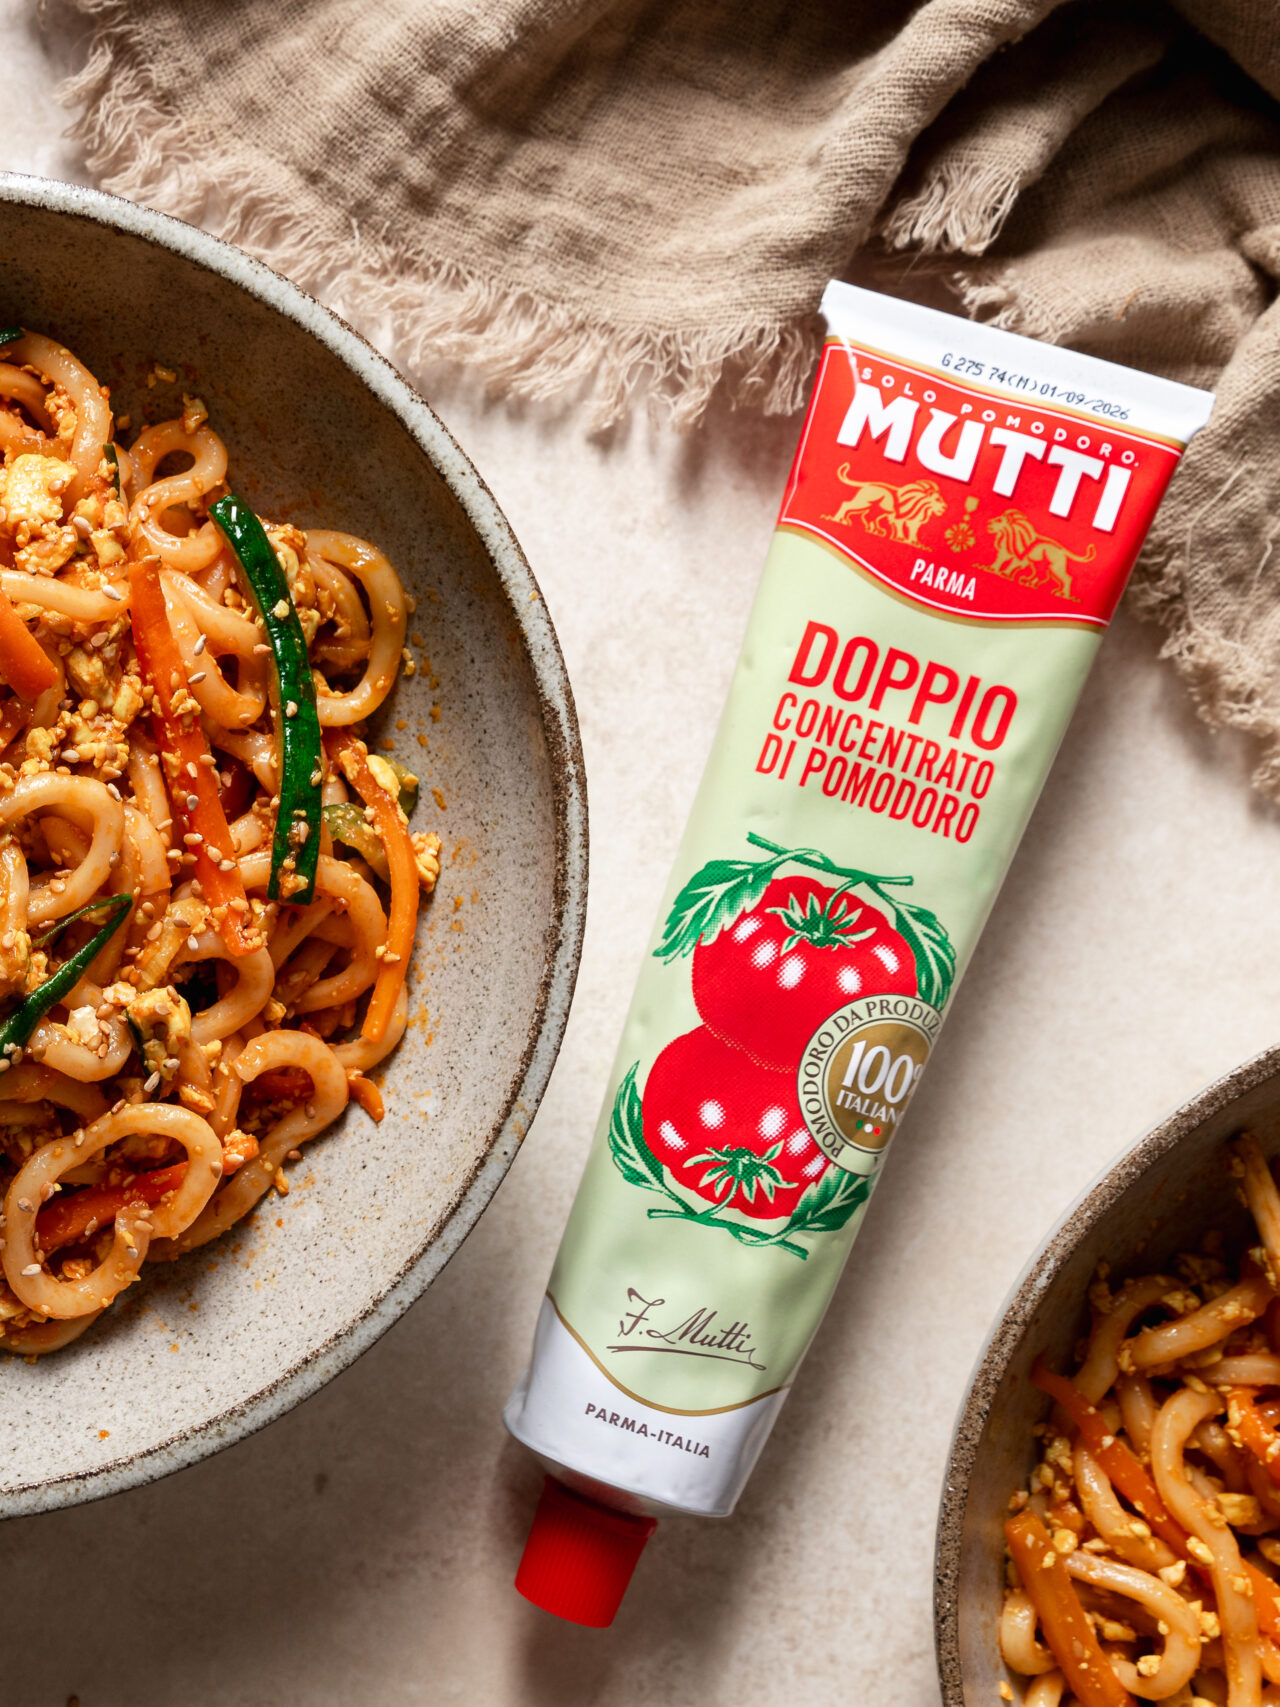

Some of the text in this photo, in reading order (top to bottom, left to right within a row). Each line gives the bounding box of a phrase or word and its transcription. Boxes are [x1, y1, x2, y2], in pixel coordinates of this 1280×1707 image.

[861, 367, 936, 403] SOLO
[836, 382, 1132, 533] MUTTI
[910, 559, 976, 601] PARMA
[787, 620, 1018, 751] DOPPIO
[755, 733, 981, 844] DI POMODORO
[773, 692, 995, 800] CONCENTRATO
[803, 1031, 846, 1158] POMODORO
[832, 1008, 864, 1033] DA
[646, 1307, 758, 1355] Mutti
[584, 1402, 712, 1459] PARMA-ITALIA
